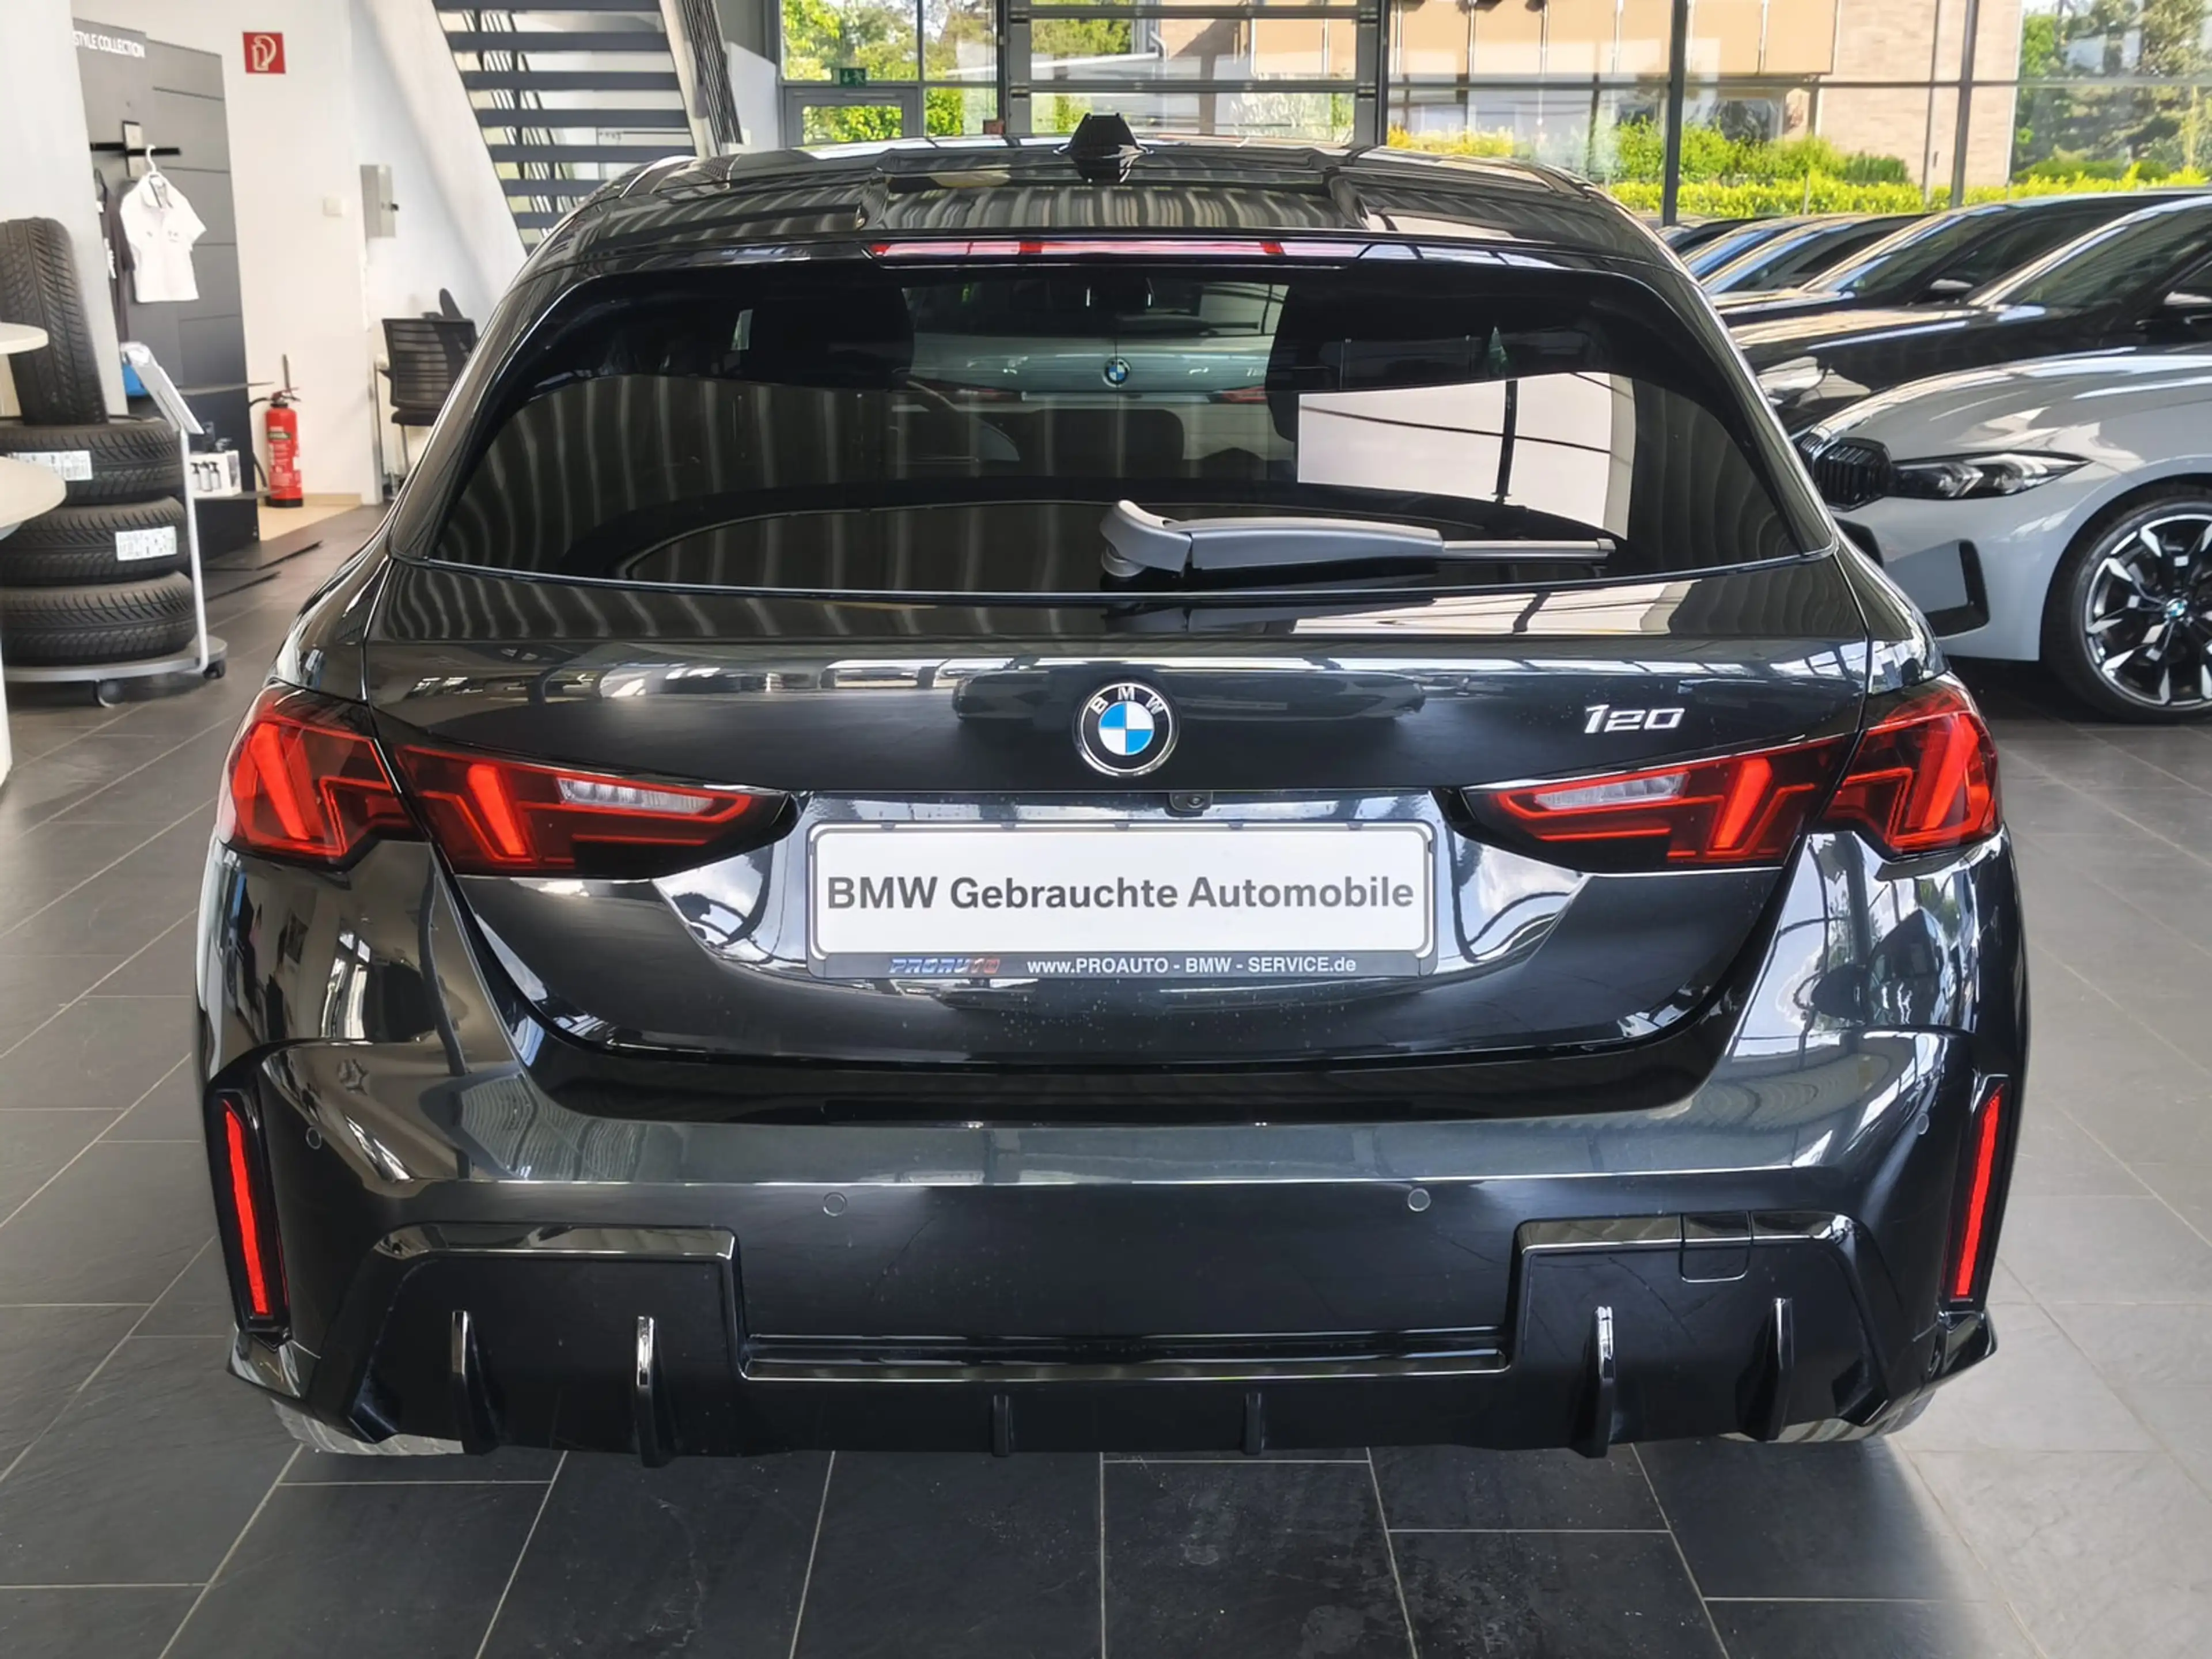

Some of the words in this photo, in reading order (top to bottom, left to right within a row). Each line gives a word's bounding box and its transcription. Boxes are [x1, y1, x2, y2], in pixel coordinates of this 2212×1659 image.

[1089, 685, 1164, 715] BMW
[1584, 704, 1685, 734] 120
[828, 876, 938, 909] BMW
[950, 877, 1179, 909] Gebrauchte
[1187, 876, 1414, 908] Automobile
[889, 958, 1001, 974] PROAUTO
[1027, 957, 1169, 974] www.PROAUTO
[1185, 957, 1232, 973] BMW
[1248, 957, 1357, 972] SERVICE.de
